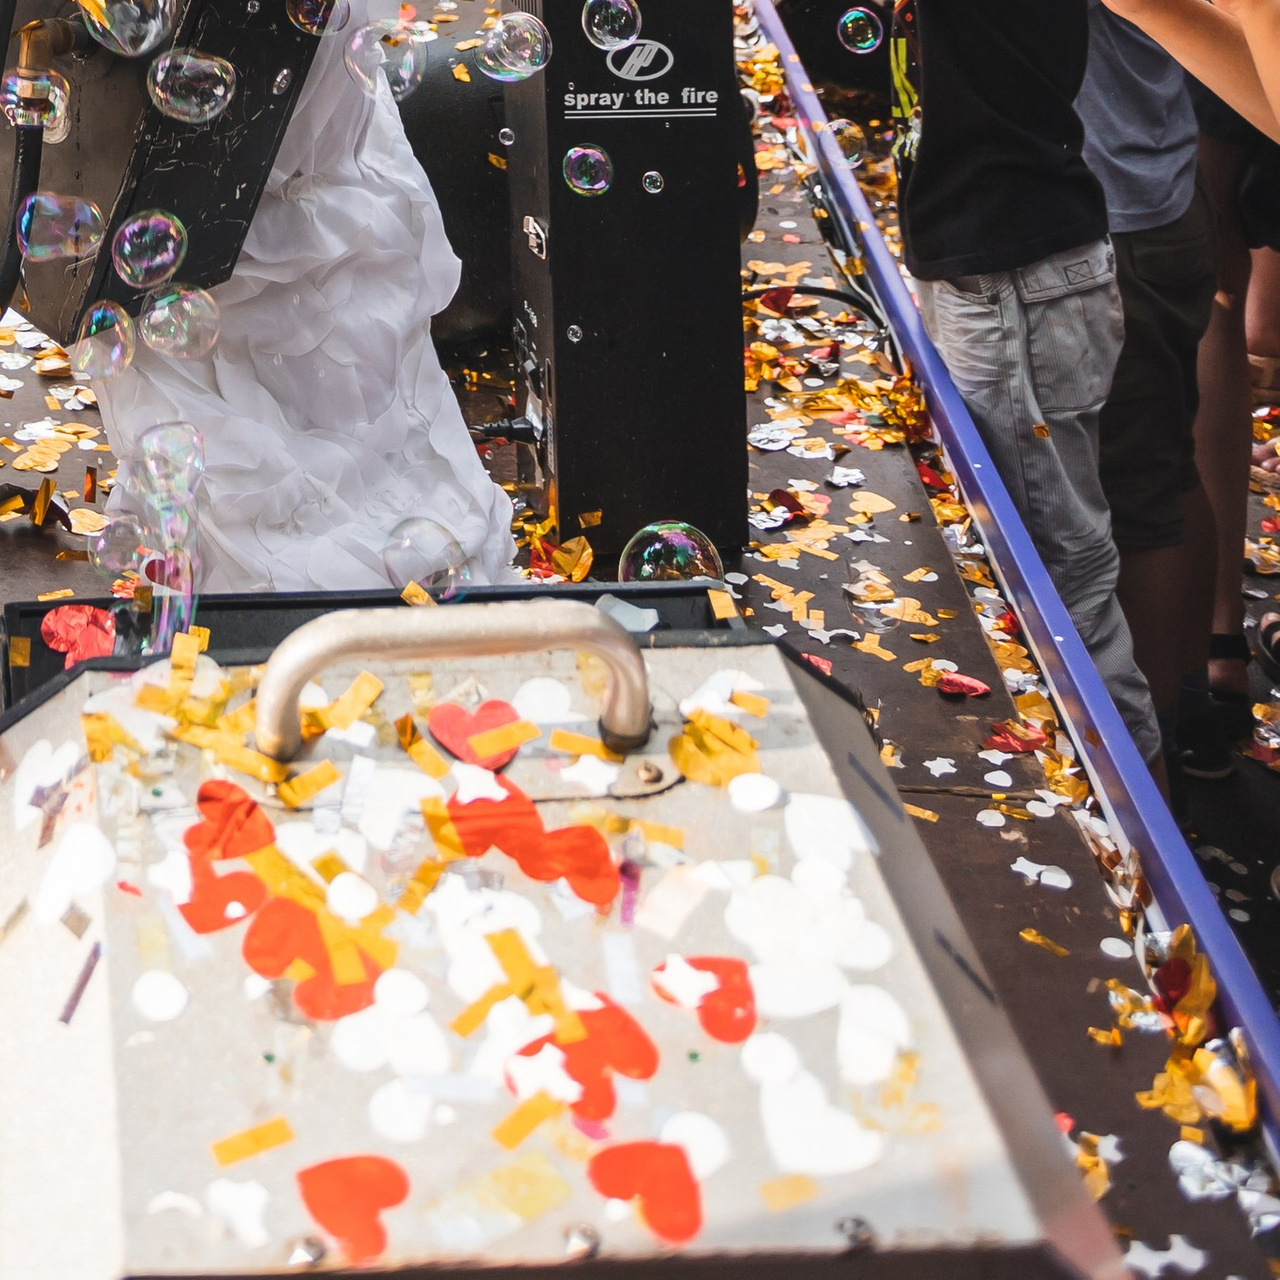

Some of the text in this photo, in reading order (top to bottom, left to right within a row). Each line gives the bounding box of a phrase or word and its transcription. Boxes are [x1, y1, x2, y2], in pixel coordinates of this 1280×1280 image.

[563, 86, 719, 110] spray the fire
